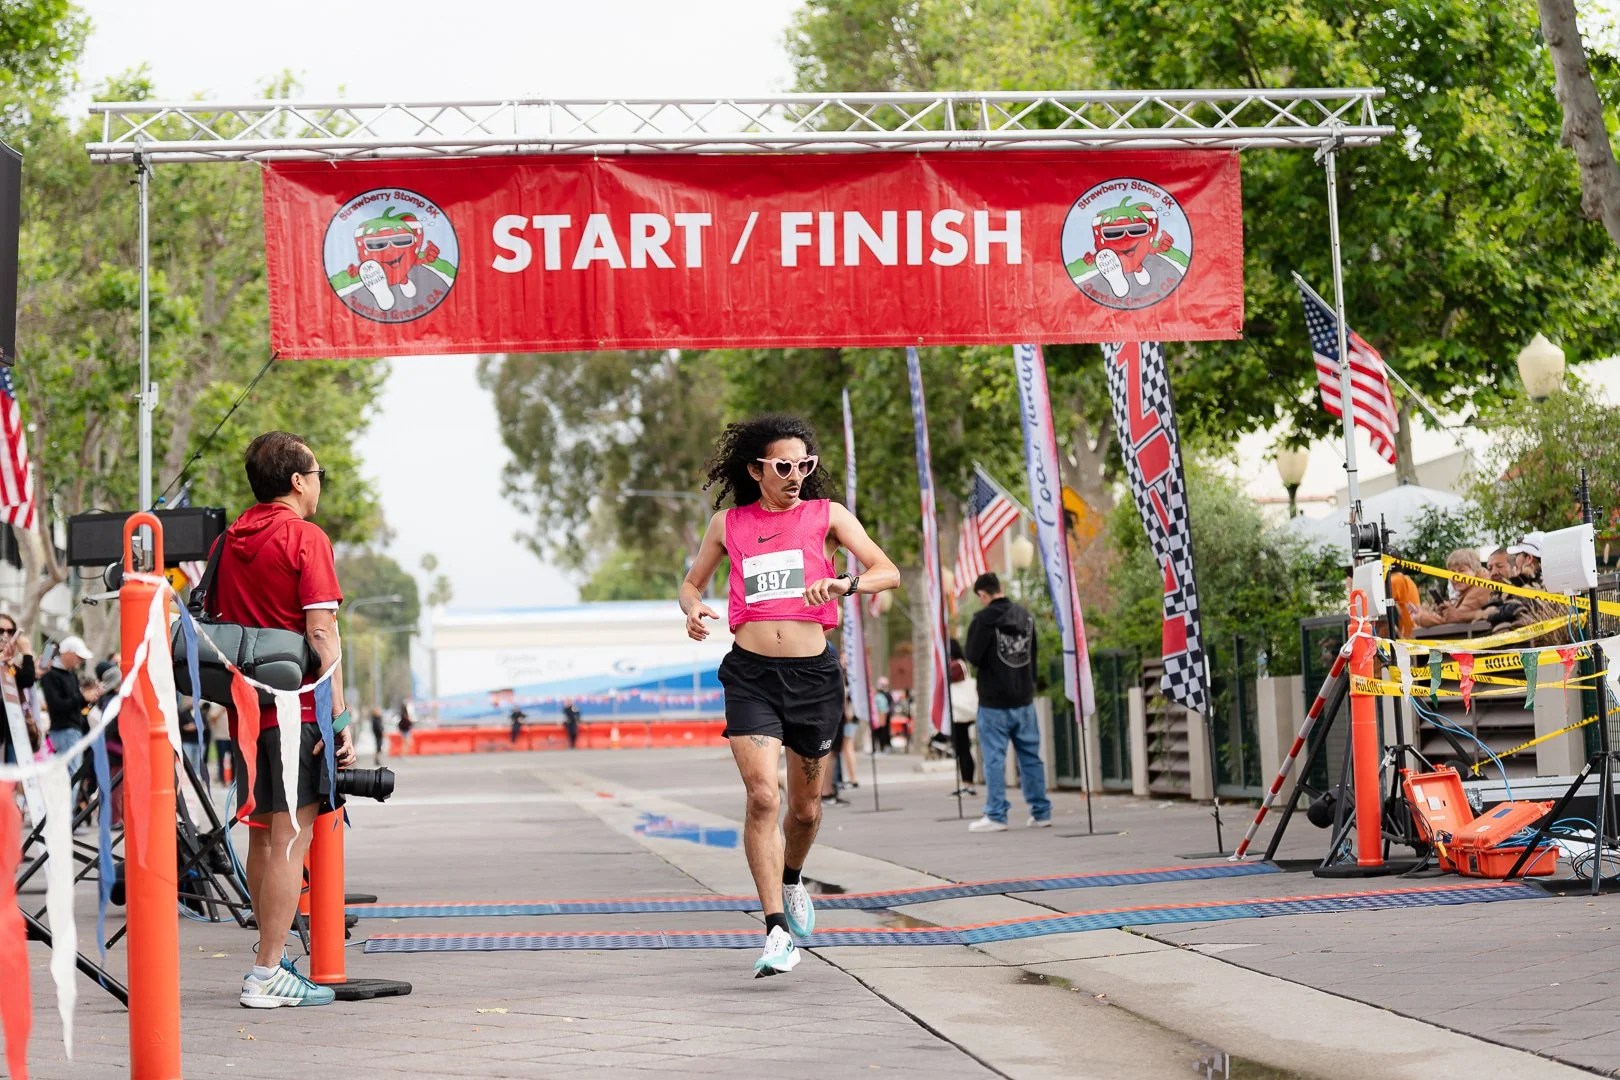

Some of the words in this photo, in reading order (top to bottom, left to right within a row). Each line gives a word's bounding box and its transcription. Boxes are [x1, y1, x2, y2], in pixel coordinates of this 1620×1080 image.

[339, 192, 391, 221] Strawberry
[394, 191, 425, 208] Stomp
[425, 205, 440, 219] 5K
[1077, 182, 1129, 210] Strawberry
[1131, 181, 1161, 199] Stomp
[1161, 195, 1175, 210] 5K
[491, 213, 712, 273] START
[730, 211, 759, 265] /
[780, 209, 1022, 267] FINISH
[757, 570, 791, 592] 897
